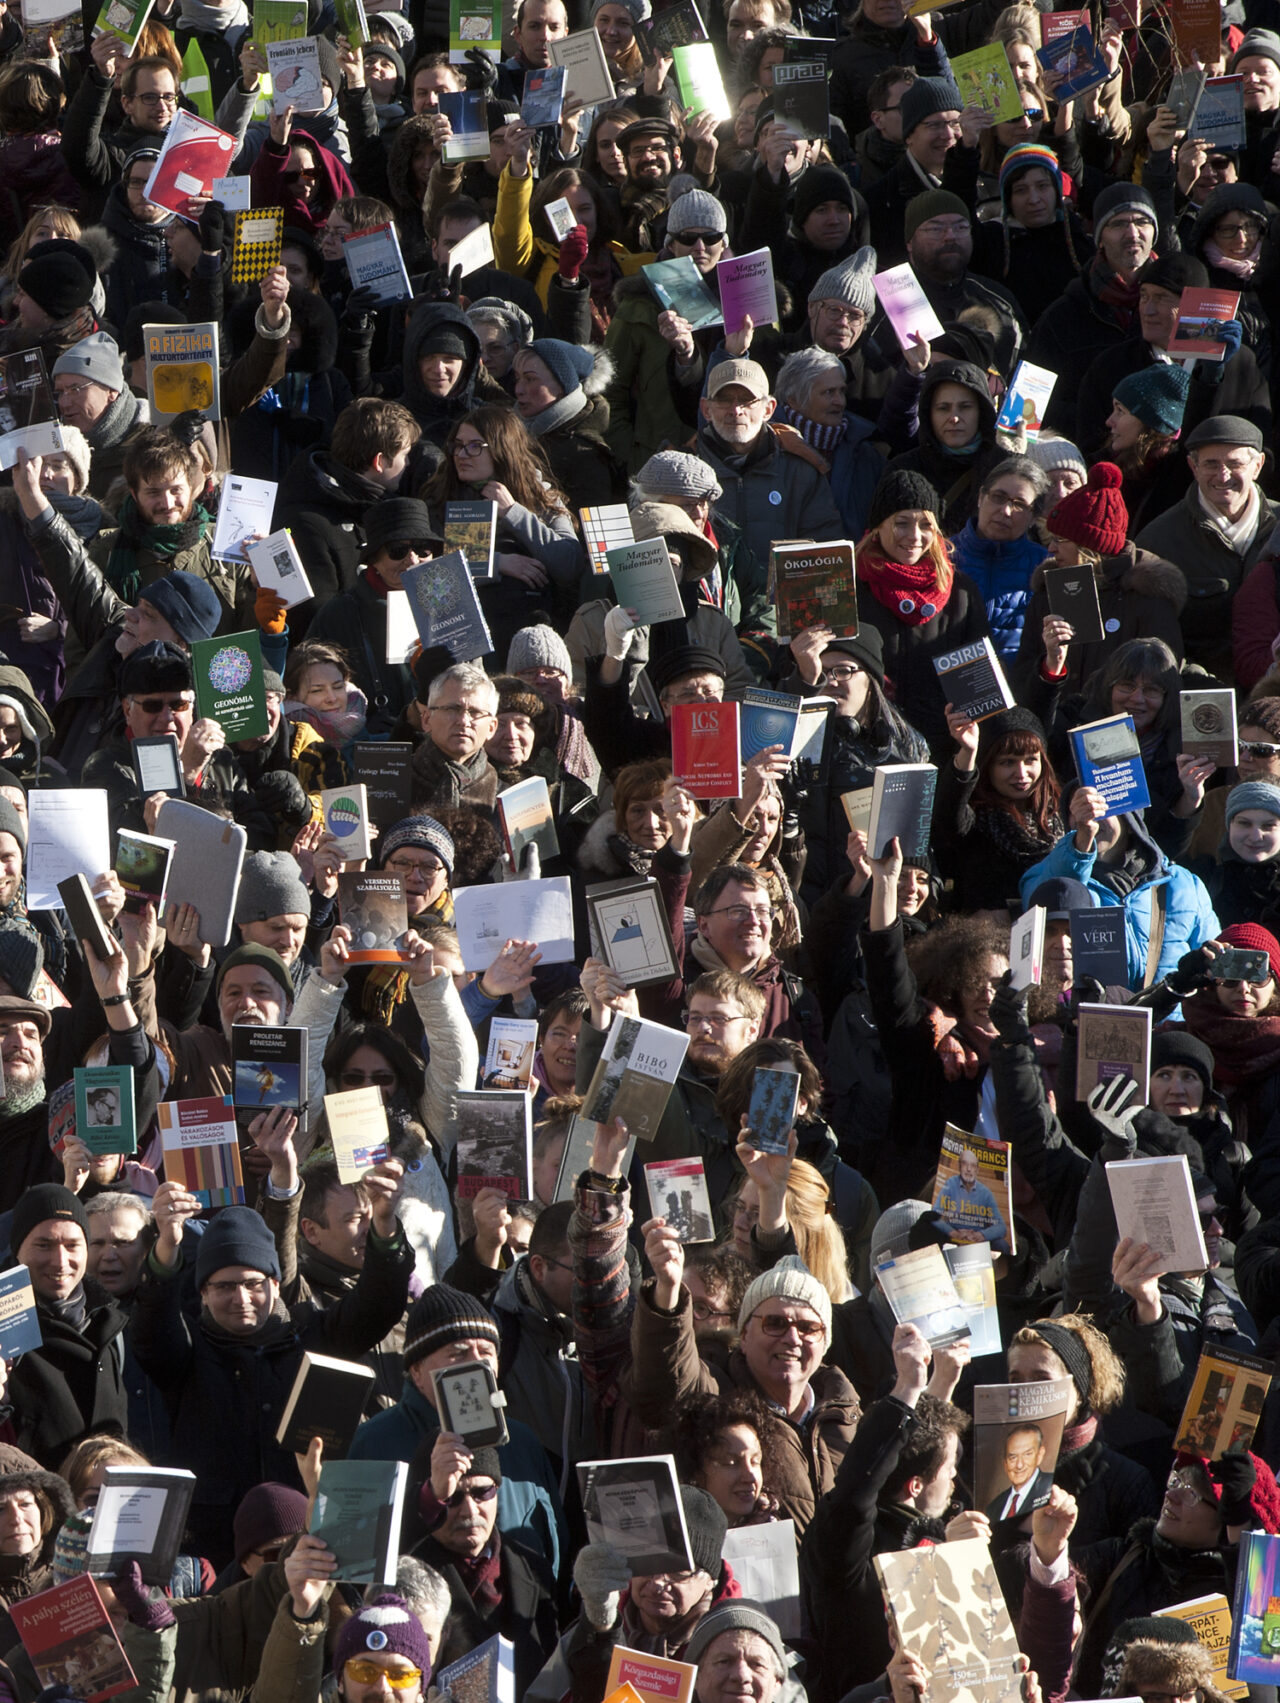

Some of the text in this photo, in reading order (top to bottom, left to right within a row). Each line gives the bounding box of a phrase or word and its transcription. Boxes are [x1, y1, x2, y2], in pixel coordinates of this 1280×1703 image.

[776, 63, 825, 85] prae
[356, 261, 384, 274] MAGYAR
[360, 264, 396, 280] TUDOMÁNY
[734, 260, 767, 274] Magyar
[724, 267, 768, 283] Tudomány
[150, 334, 212, 352] A FIZIKA
[626, 547, 662, 563] Magyar
[615, 557, 664, 574] Tudomány
[784, 556, 844, 570] ÖKOLÓGIA
[431, 613, 466, 633] GEONOMY
[938, 642, 986, 670] OSIRIS
[214, 695, 254, 709] GEONÓMIA
[966, 697, 1002, 717] ELVTAN
[691, 711, 719, 729] ICS
[358, 768, 378, 776] György
[249, 1039, 287, 1047] RENESZÁNSZ
[253, 1032, 283, 1040] PROLETÁR
[636, 1052, 668, 1070] BIBÓ
[634, 1062, 665, 1077] ISTVÁN
[180, 1124, 224, 1135] VÁRAKOZÁSOK
[188, 1130, 225, 1140] VALÓSÁGOK
[942, 1137, 964, 1153] MAGYAR
[464, 1178, 514, 1187] BUDAPEST
[941, 1195, 959, 1210] Kis
[960, 1198, 993, 1217] János
[1018, 1384, 1056, 1397] MAGYAR
[1018, 1391, 1069, 1406] KÉMIKUSOK
[1019, 1405, 1045, 1417] LAPJA
[22, 1614, 33, 1627] A
[34, 1602, 60, 1625] pálya
[62, 1591, 93, 1613] szélén
[1190, 1615, 1220, 1631] RPÁT-
[1196, 1627, 1220, 1640] NCE
[1200, 1636, 1231, 1650] AJZA
[623, 1662, 678, 1686] Közgazdasági
[952, 1671, 967, 1682] 150
[633, 1676, 663, 1692] Szemle
